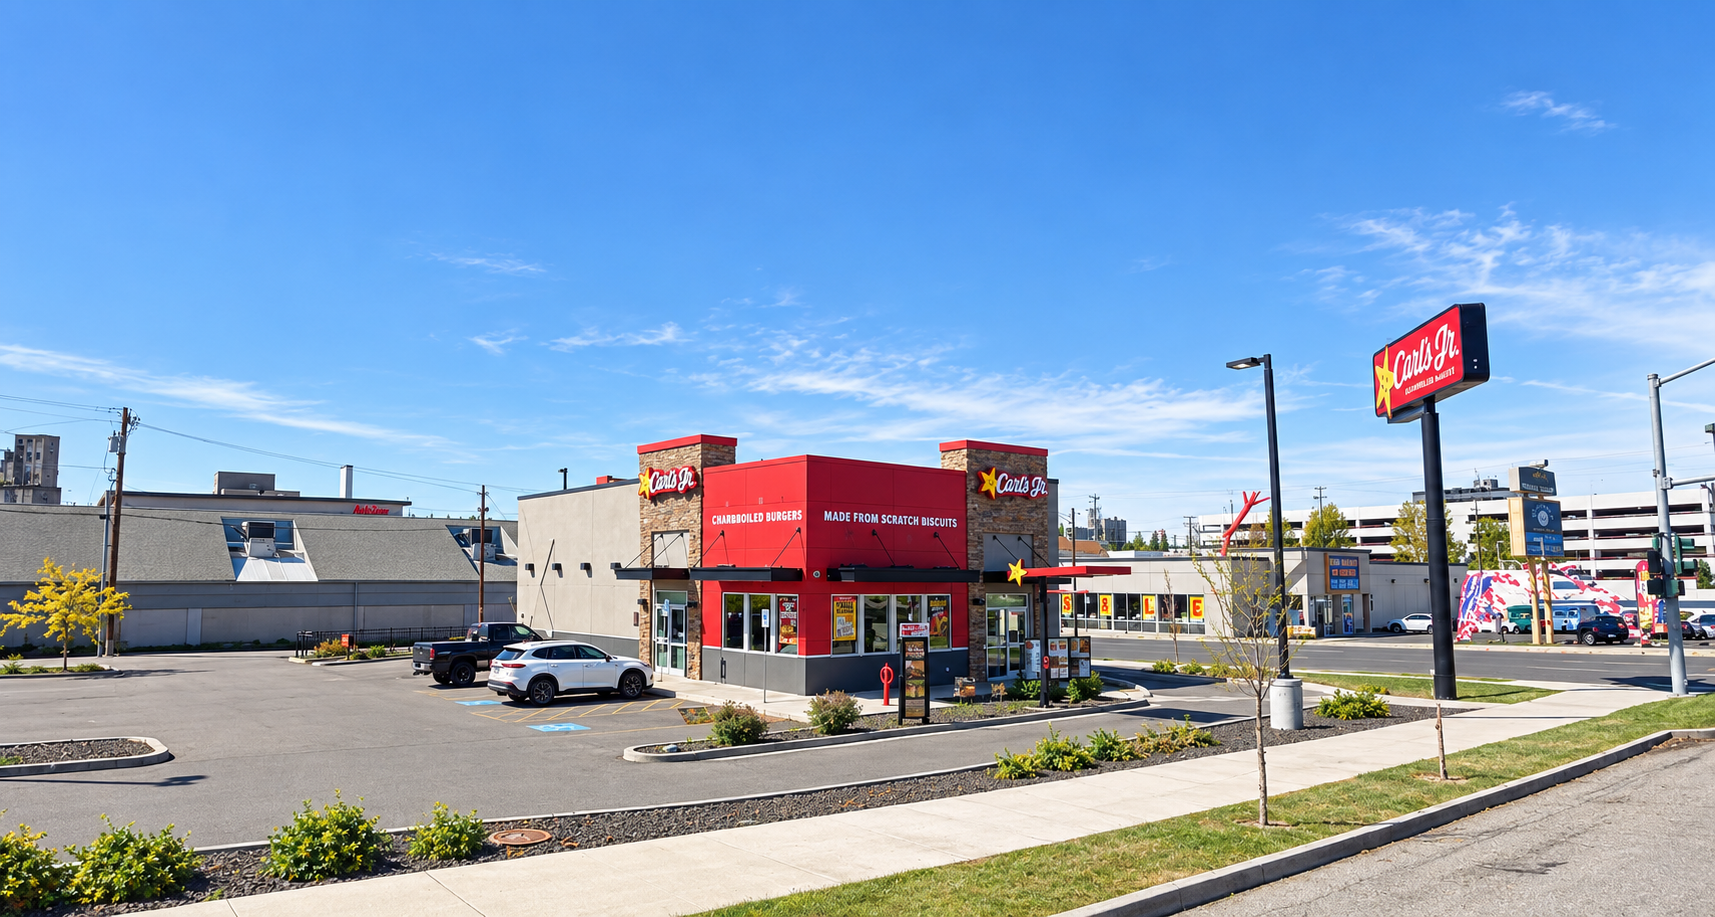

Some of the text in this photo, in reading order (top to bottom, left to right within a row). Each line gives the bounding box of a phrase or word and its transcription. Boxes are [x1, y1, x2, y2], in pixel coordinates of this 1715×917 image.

[1393, 323, 1459, 389] Carl's Jr.
[649, 469, 677, 493] Carl's
[996, 472, 1029, 494] Carl's
[765, 509, 803, 522] BURGERS
[823, 510, 958, 528] MADE FROM SCRATCH BISCUITS
